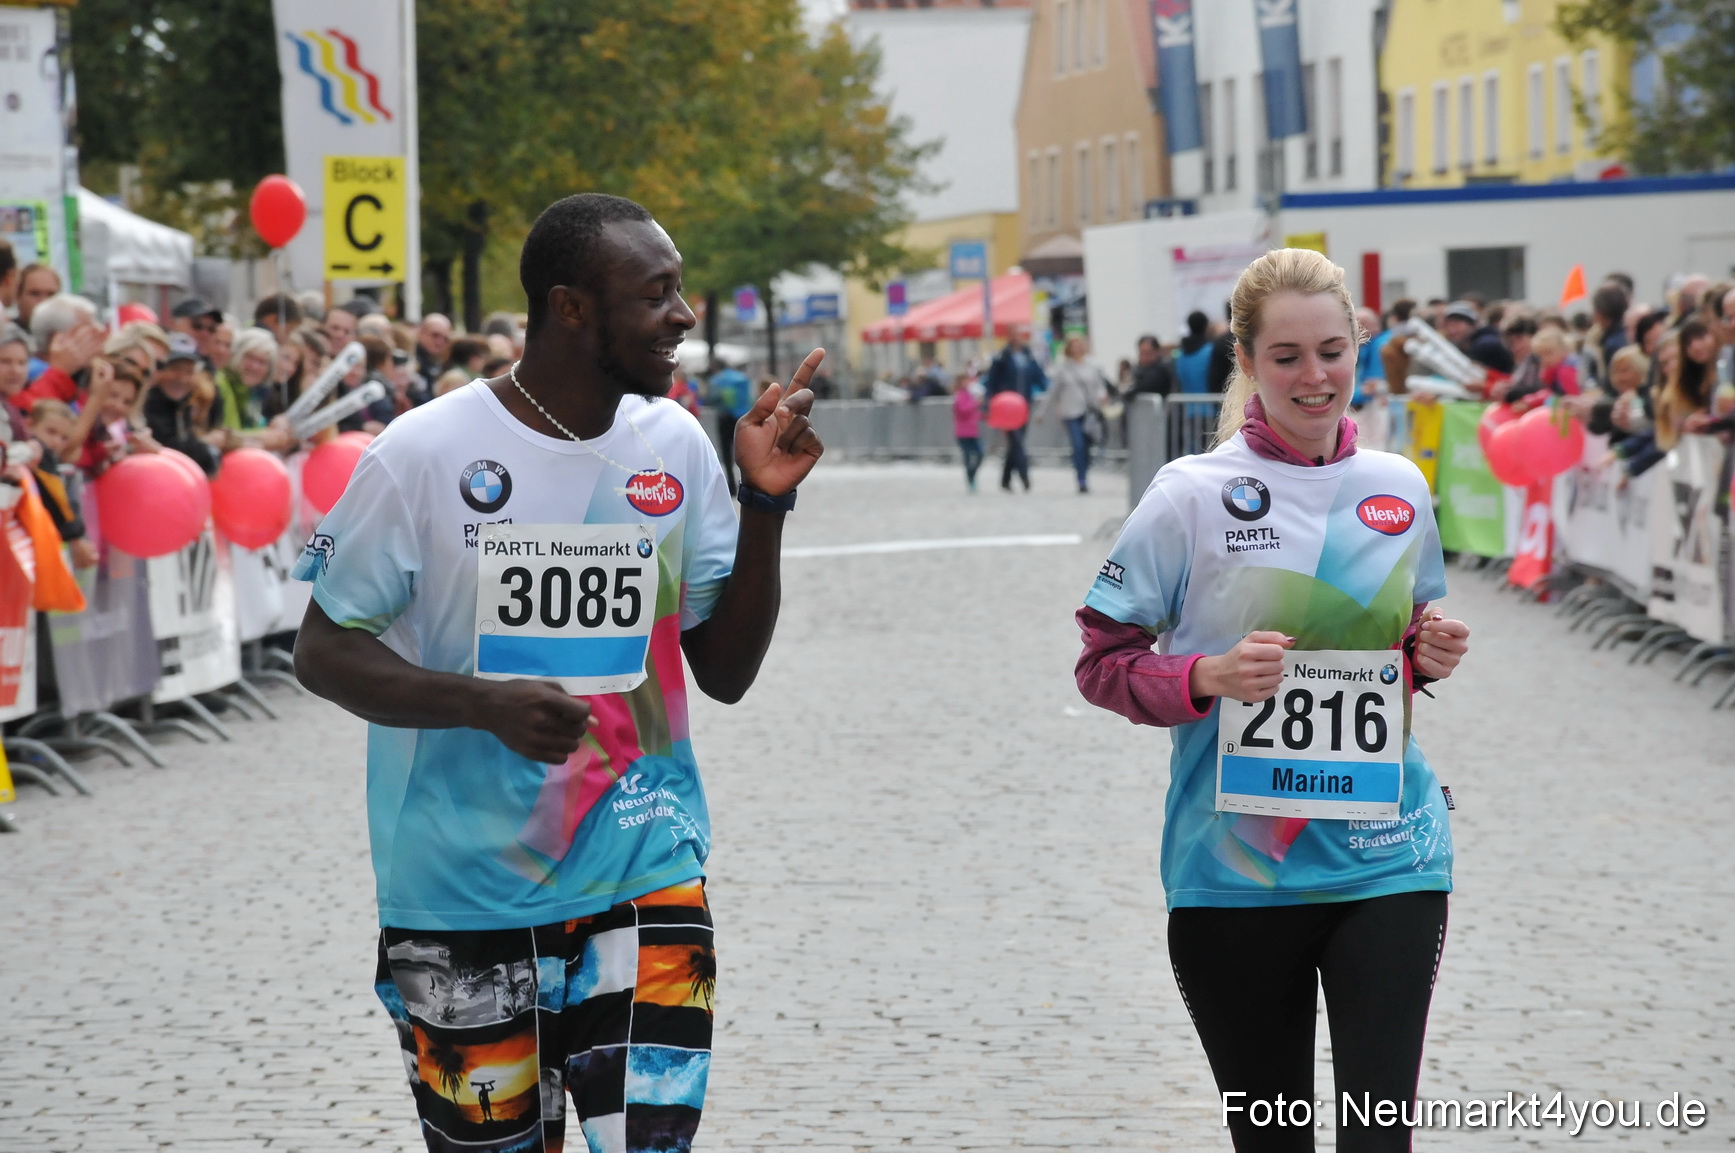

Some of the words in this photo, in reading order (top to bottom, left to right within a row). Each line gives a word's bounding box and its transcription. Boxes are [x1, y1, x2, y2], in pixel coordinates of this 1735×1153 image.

[333, 160, 396, 182] Block
[345, 194, 383, 252] C
[463, 461, 505, 480] BMW
[1224, 478, 1265, 492] BMW
[1363, 505, 1410, 525] Hervis
[1225, 527, 1280, 543] PARTL
[484, 541, 546, 556] PARTL
[551, 541, 631, 557] Neumarkt
[1226, 541, 1281, 554] Neumarkt
[497, 566, 643, 629] 3085
[1294, 663, 1374, 682] Neumarkt
[1240, 688, 1388, 753] 2816
[1227, 742, 1234, 753] D
[1272, 767, 1353, 794] Marina
[1348, 825, 1416, 849] Stadtlauf
